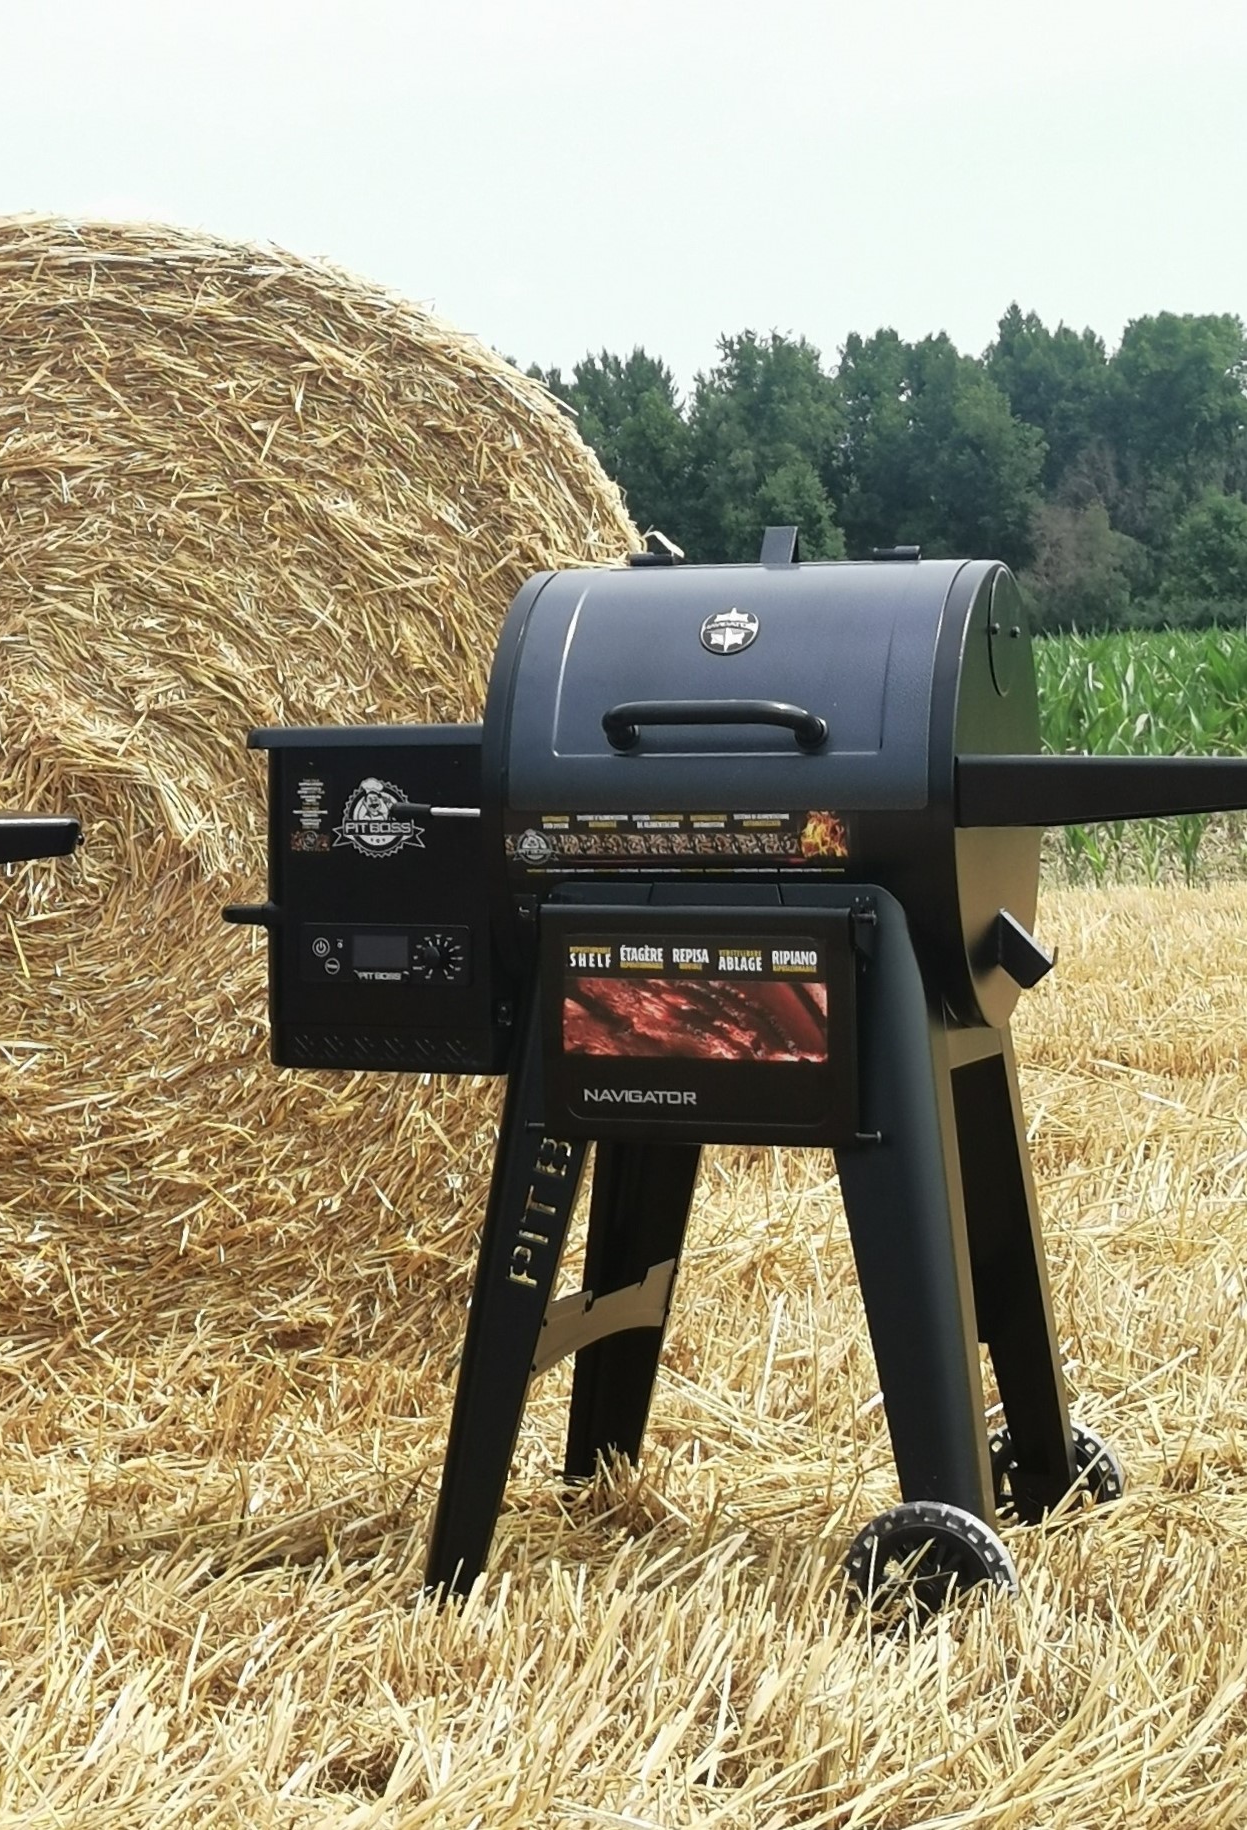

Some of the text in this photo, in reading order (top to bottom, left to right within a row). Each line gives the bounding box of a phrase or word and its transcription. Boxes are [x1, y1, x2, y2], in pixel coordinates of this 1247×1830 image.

[345, 822, 412, 834] PIT BOSS
[569, 953, 612, 969] SHELF
[619, 945, 664, 963] ÉTAGÈRE
[672, 948, 710, 963] REPISA
[772, 950, 817, 966] RIPIANO
[718, 957, 762, 972] ABLAGE
[374, 971, 402, 981] BOSS
[583, 1088, 697, 1105] NAVIGATOR
[506, 1184, 557, 1289] PIT
